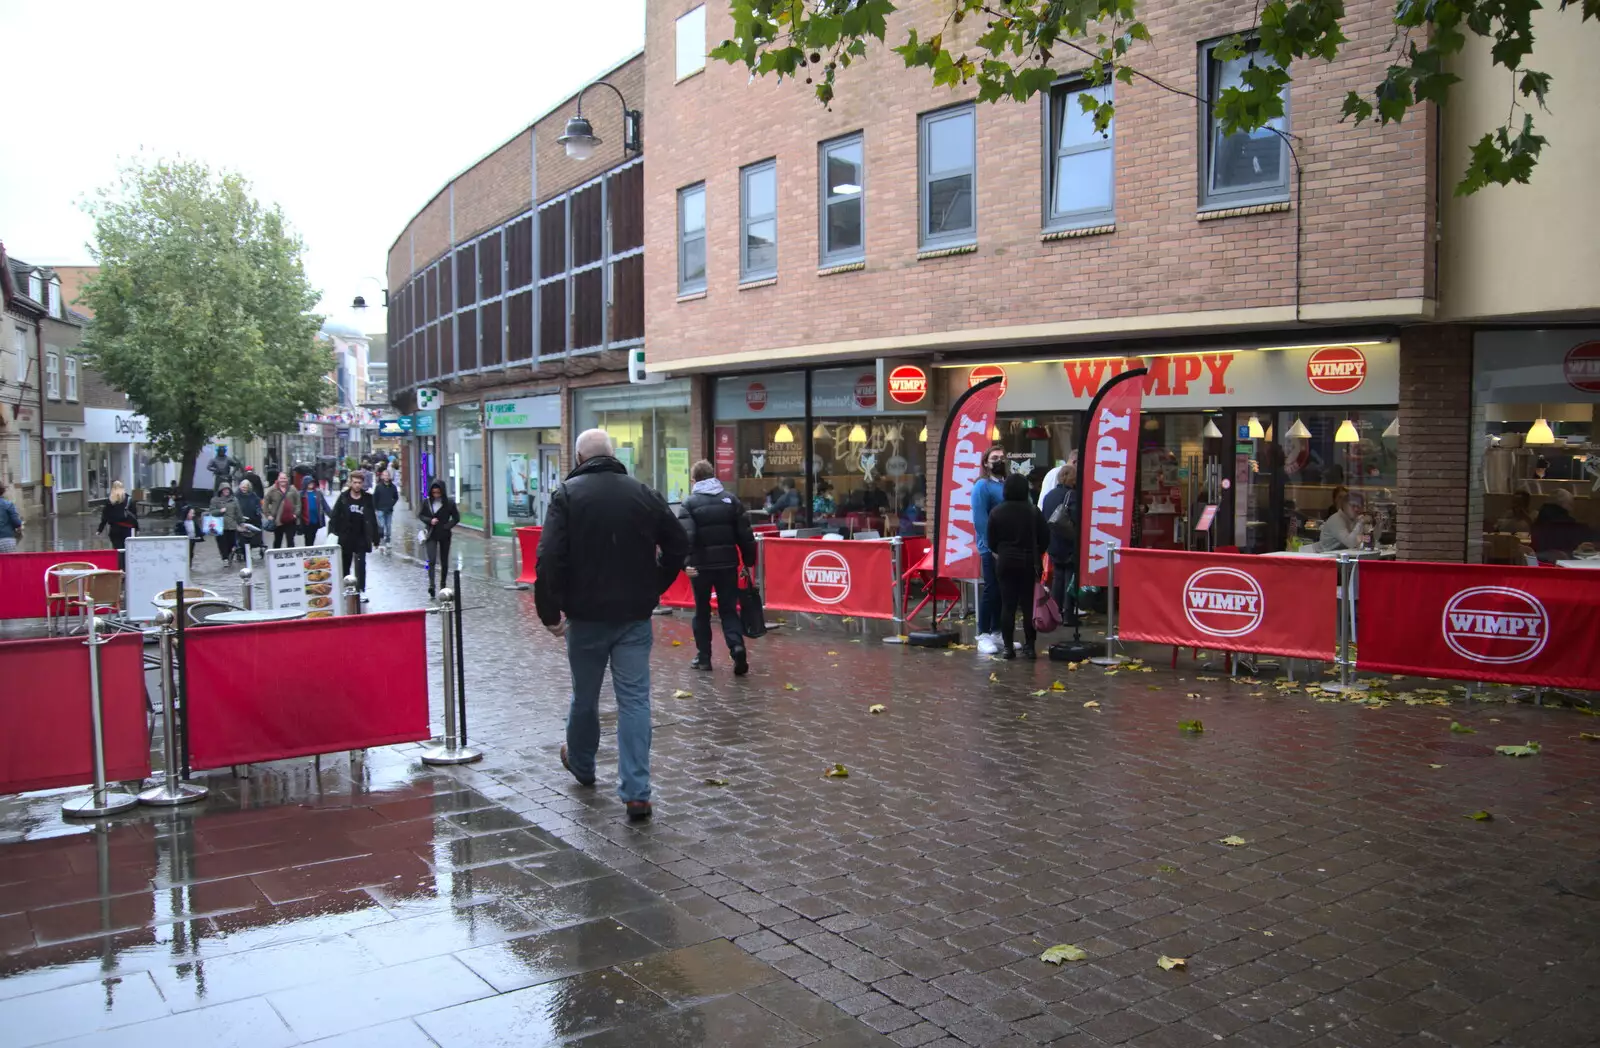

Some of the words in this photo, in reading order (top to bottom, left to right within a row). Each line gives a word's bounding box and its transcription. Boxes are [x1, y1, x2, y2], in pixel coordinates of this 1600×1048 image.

[1308, 362, 1365, 377] WIMPY
[888, 379, 927, 391] WIMPY
[768, 455, 803, 465] WIMPY
[944, 414, 987, 566] WIMPY
[1088, 407, 1131, 574] WIMPY
[805, 569, 848, 584] WIMPY
[1188, 591, 1259, 613] WIMPY
[1449, 613, 1542, 636] WIMPY
